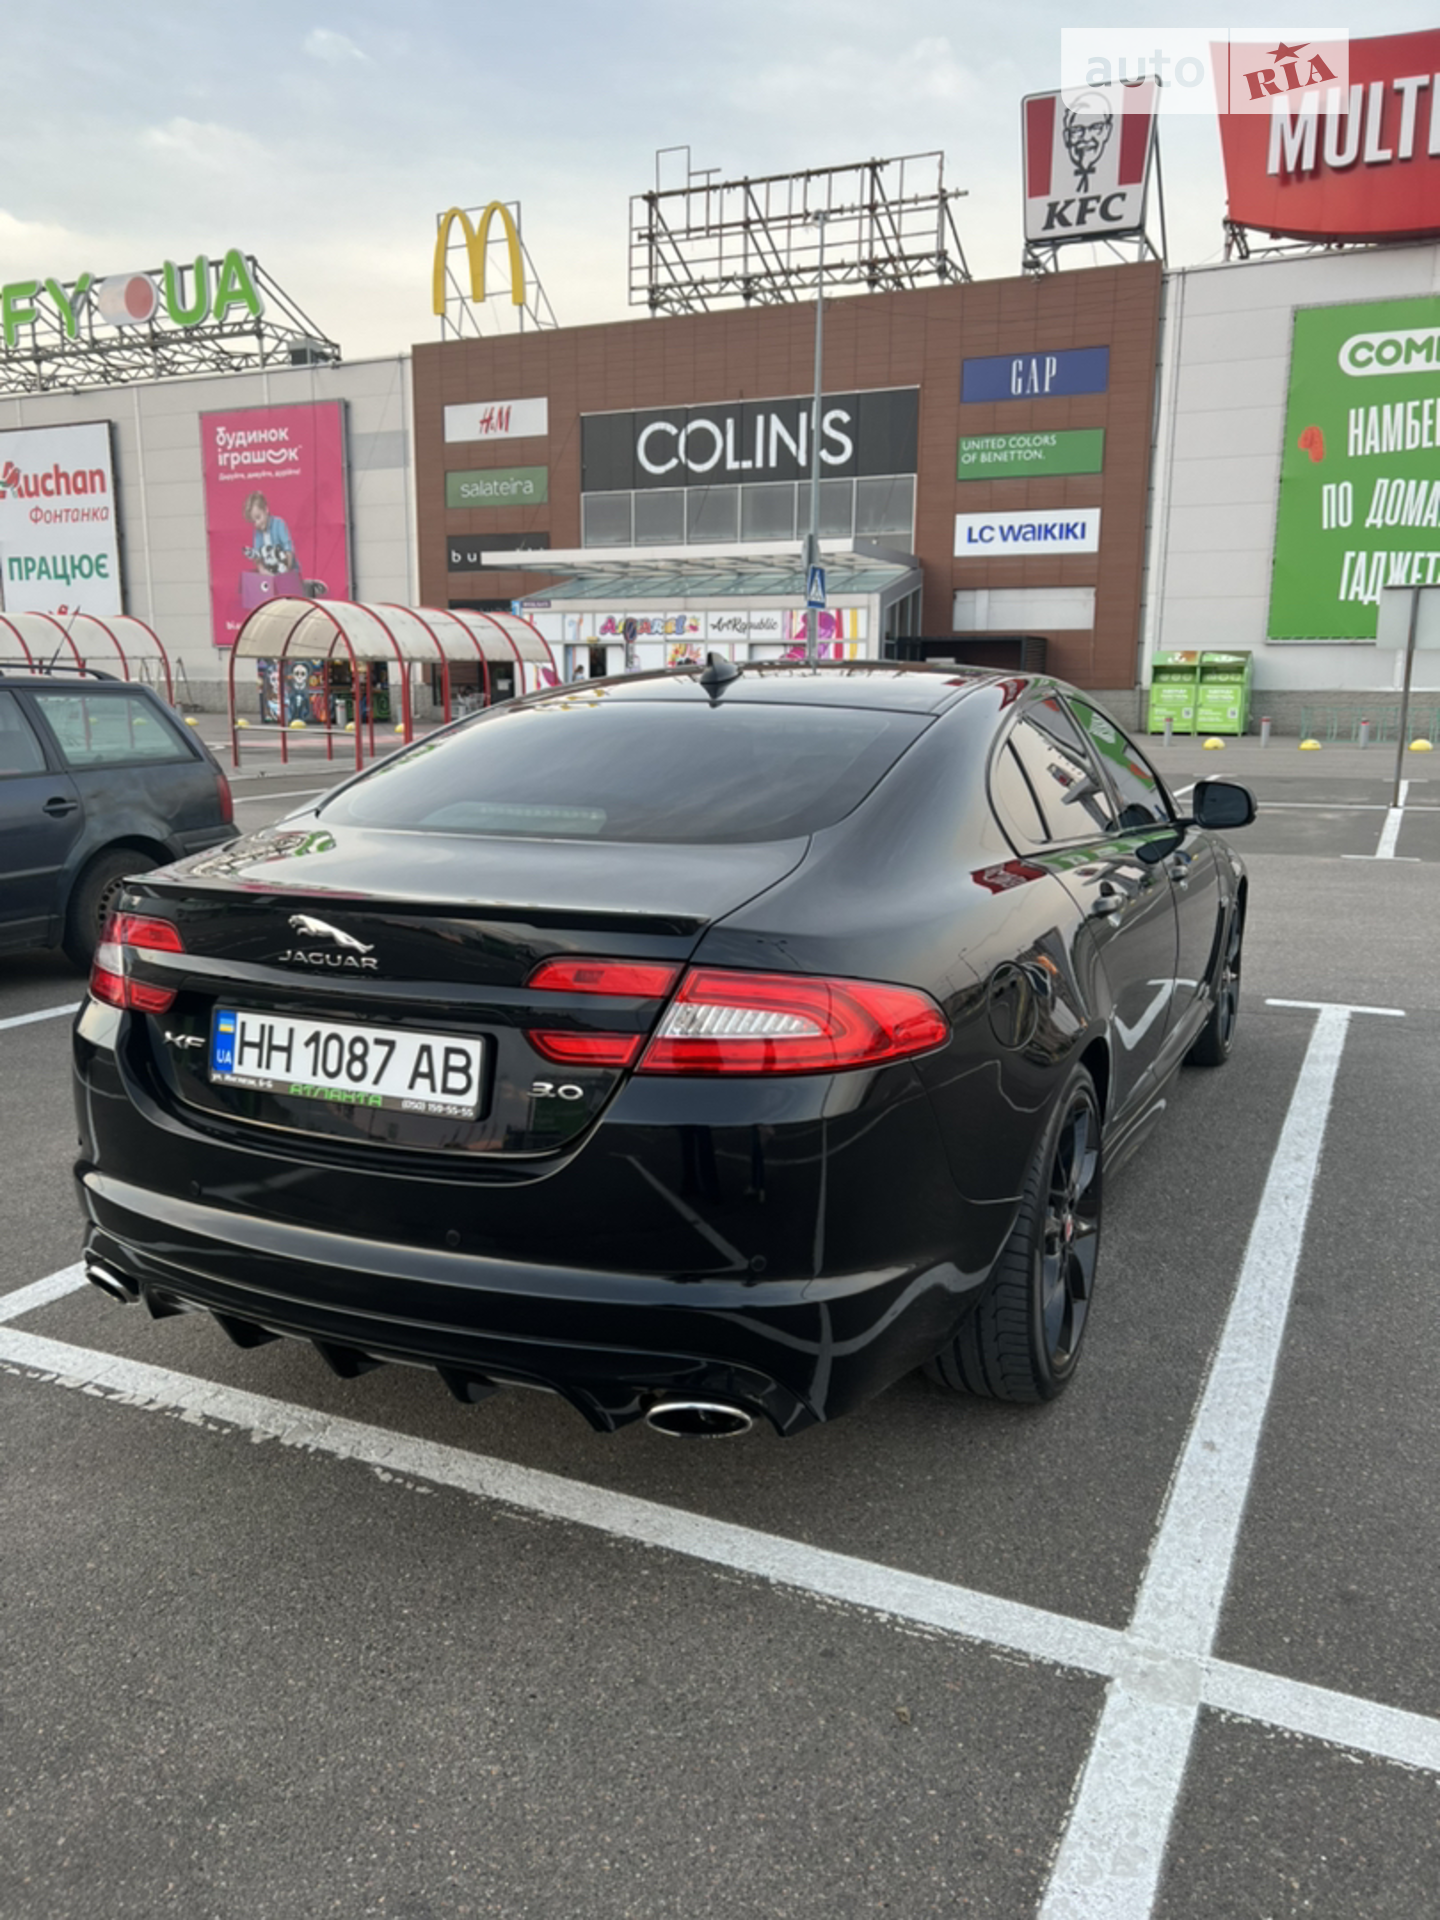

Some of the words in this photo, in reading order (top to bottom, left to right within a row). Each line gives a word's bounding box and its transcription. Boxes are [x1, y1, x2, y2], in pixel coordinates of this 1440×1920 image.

[1042, 192, 1127, 231] KFC
[1348, 335, 1440, 369] COM
[1011, 356, 1057, 396] GAP
[216, 426, 289, 450] будинок
[1348, 398, 1440, 457] НАМБЕ
[962, 438, 1006, 451] UNITED
[1008, 435, 1057, 449] COLORS
[961, 453, 977, 464] OF
[0, 461, 106, 499] Auchan
[460, 477, 534, 498] salateira
[29, 505, 109, 524] Фонтанка
[1322, 481, 1353, 530] ПО
[1365, 478, 1440, 529] ДОМА
[967, 525, 995, 543] LC
[8, 553, 109, 586] ПРАЦЮЄ
[1338, 551, 1440, 605] ГАДЖЕТ
[278, 949, 378, 970] JAGUAR
[164, 1031, 206, 1049] XF
[216, 1048, 233, 1065] UA
[238, 1021, 294, 1073] HH
[304, 1030, 396, 1086] 1087
[408, 1043, 473, 1096] AB
